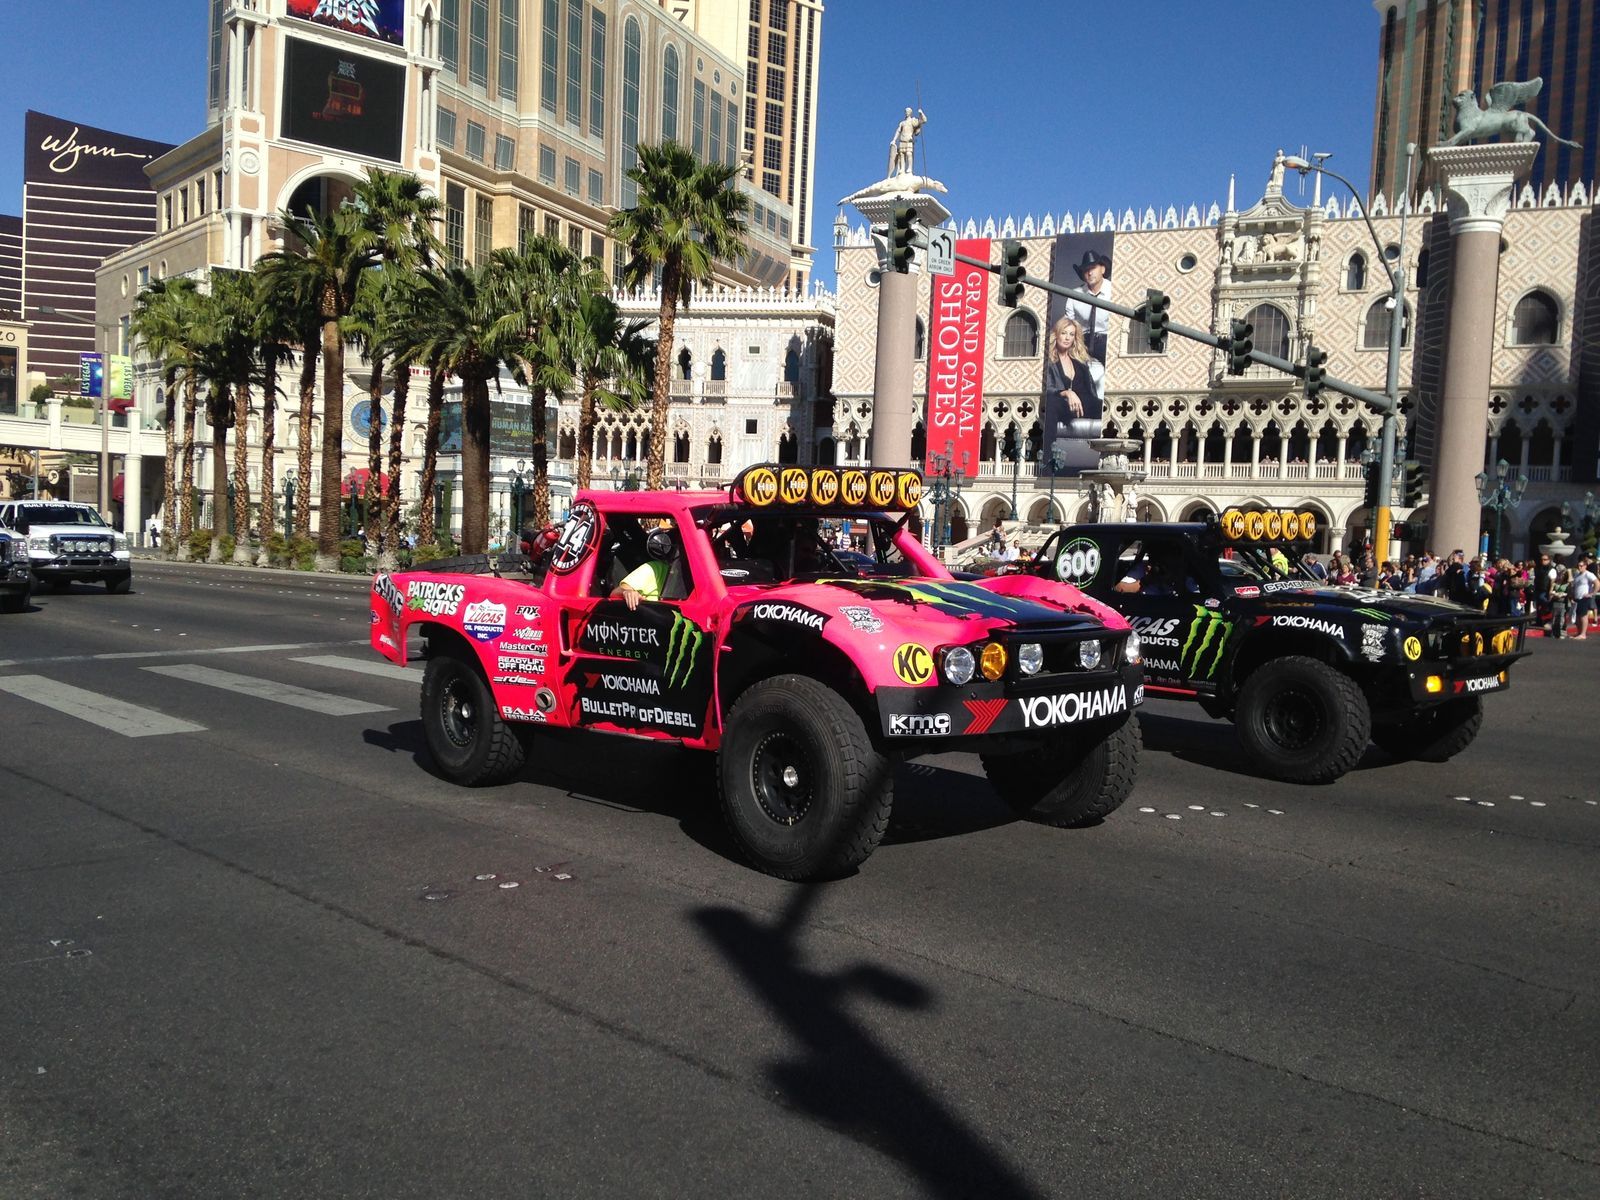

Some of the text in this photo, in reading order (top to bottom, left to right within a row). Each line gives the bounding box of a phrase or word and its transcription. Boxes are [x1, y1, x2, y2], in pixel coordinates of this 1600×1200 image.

[934, 282, 963, 427] SHOPPES
[959, 272, 982, 438] GRAND CANAL
[82, 362, 91, 381] VEGAS
[751, 472, 773, 502] KC
[758, 482, 775, 491] HID
[783, 471, 805, 499] KC
[790, 480, 807, 489] HID
[817, 472, 836, 501] KC
[846, 473, 864, 501] KC
[875, 474, 891, 501] KC
[904, 476, 919, 503] KC
[558, 516, 590, 555] 14
[1059, 547, 1100, 579] 600
[467, 611, 504, 624] LUCAS
[516, 605, 540, 616] FOX
[754, 604, 824, 631] YOKOHAMA
[474, 625, 504, 633] PRODUCTS
[587, 621, 660, 646] MONSTER
[1272, 615, 1345, 640] YOKOHAMA
[499, 642, 548, 653] MasterCraft
[599, 647, 650, 659] ENERGY
[1407, 639, 1420, 658] KC
[518, 663, 545, 672] ROAD
[898, 645, 929, 682] KC
[601, 674, 660, 695] YOKOHAMA
[1466, 675, 1500, 691] YOKOHAMA
[502, 706, 547, 717] BAJA
[1018, 684, 1127, 728] YOKOHAMA
